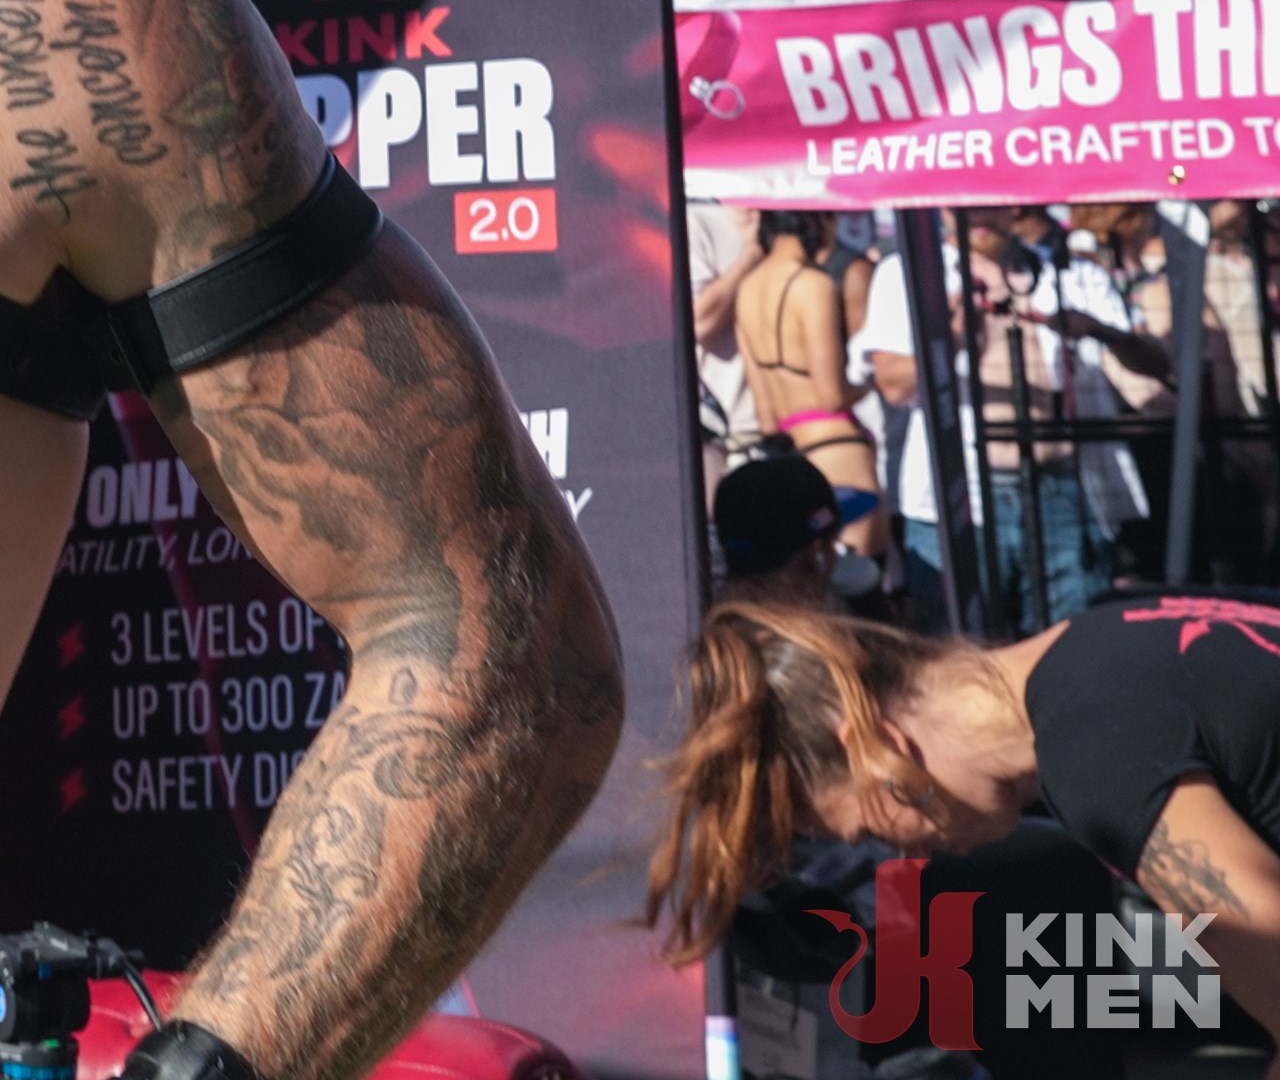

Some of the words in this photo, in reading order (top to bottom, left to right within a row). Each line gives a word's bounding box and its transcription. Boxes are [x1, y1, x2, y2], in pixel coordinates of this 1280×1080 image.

[276, 6, 453, 66] KINK
[776, 0, 1123, 126] BRINGS
[48, 0, 168, 168] concern
[296, 57, 556, 188] PPER
[806, 129, 994, 177] LEATHER
[1005, 119, 1235, 165] CRAFTED
[1243, 116, 1280, 158] T
[8, 127, 97, 224] the
[469, 197, 539, 243] 2.0
[86, 458, 199, 527] ONLY
[59, 532, 177, 576] ATILITY,
[111, 613, 131, 666] 3
[144, 600, 268, 663] LEVELS
[112, 685, 159, 739] UP
[167, 679, 211, 736] TO
[222, 674, 291, 733] 300
[304, 672, 346, 729] ZA
[111, 754, 244, 814] SAFETY
